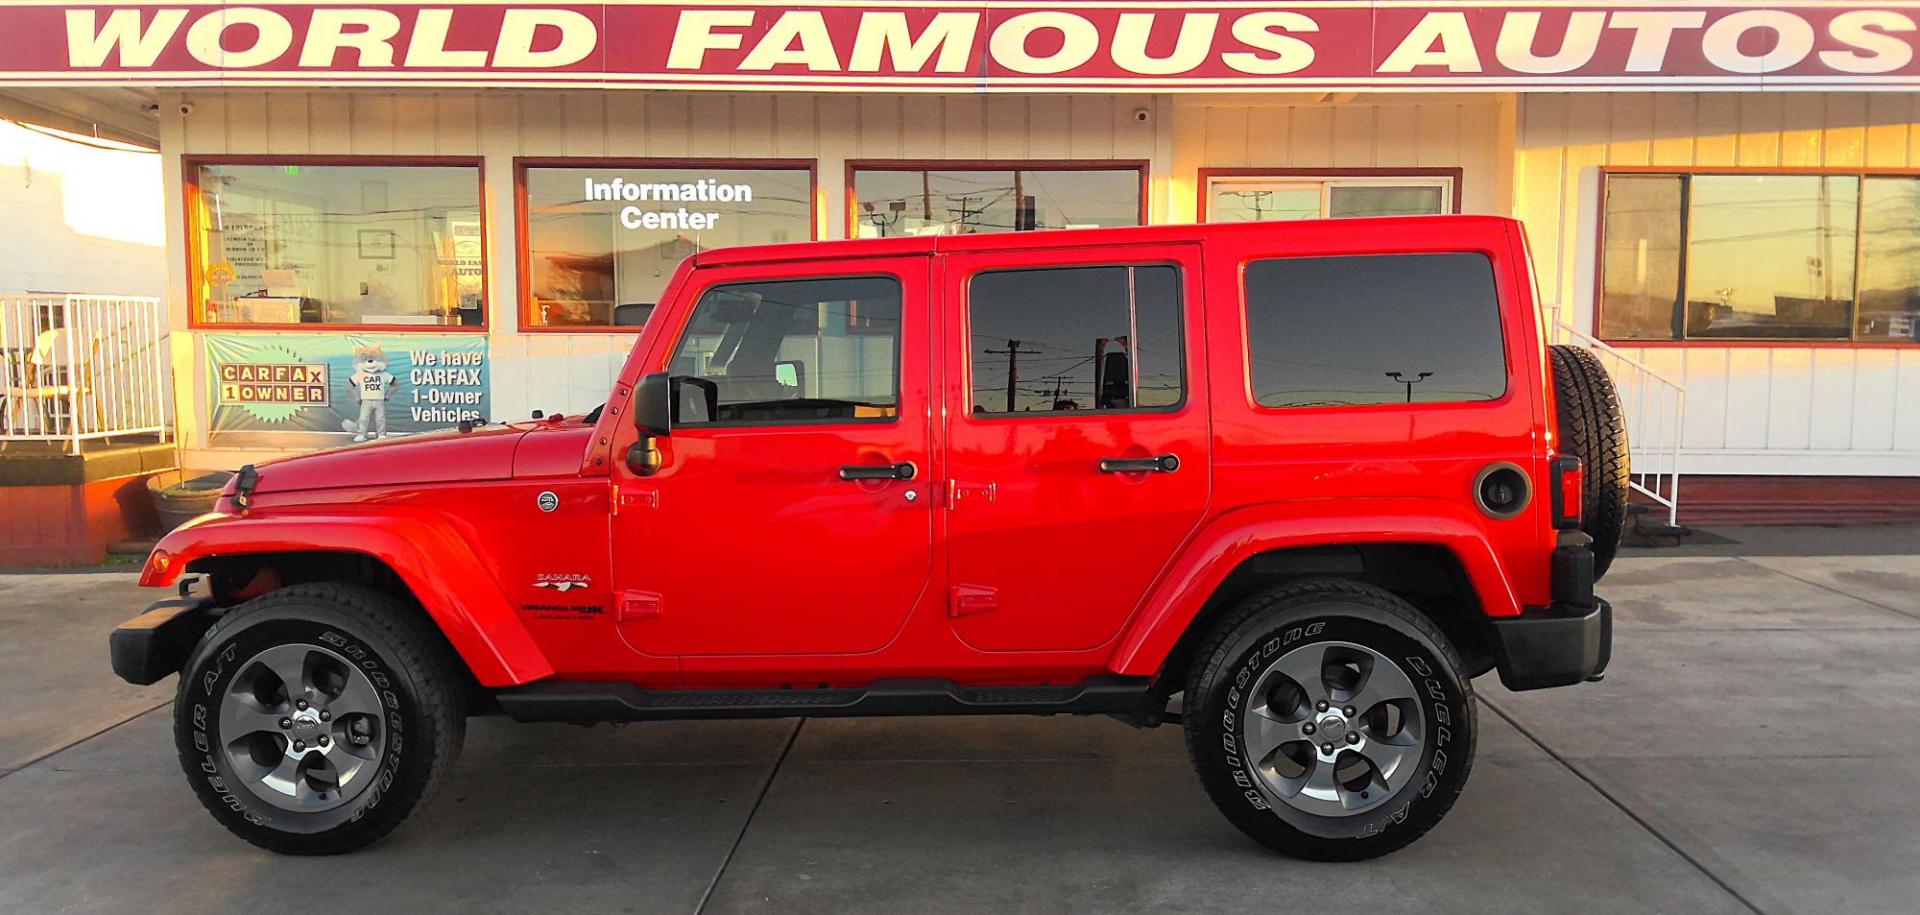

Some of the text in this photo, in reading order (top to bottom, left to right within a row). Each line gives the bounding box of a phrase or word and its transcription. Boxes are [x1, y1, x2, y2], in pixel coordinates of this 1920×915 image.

[65, 7, 1918, 75] WORLD FAMOUS AUTOS
[584, 177, 752, 203] Information
[620, 205, 720, 231] Center
[410, 350, 484, 366] We have
[221, 365, 325, 382] CARFAX
[363, 375, 382, 384] CAR
[410, 368, 481, 386] CARFAX
[241, 386, 324, 402] OWNER
[364, 383, 381, 391] FOX
[411, 388, 482, 405] 1-Owner
[410, 406, 480, 423] Vehicles
[536, 573, 592, 581] SAHARA
[1223, 621, 1326, 811] BRIDGESTONE
[1406, 655, 1450, 799] DUELER
